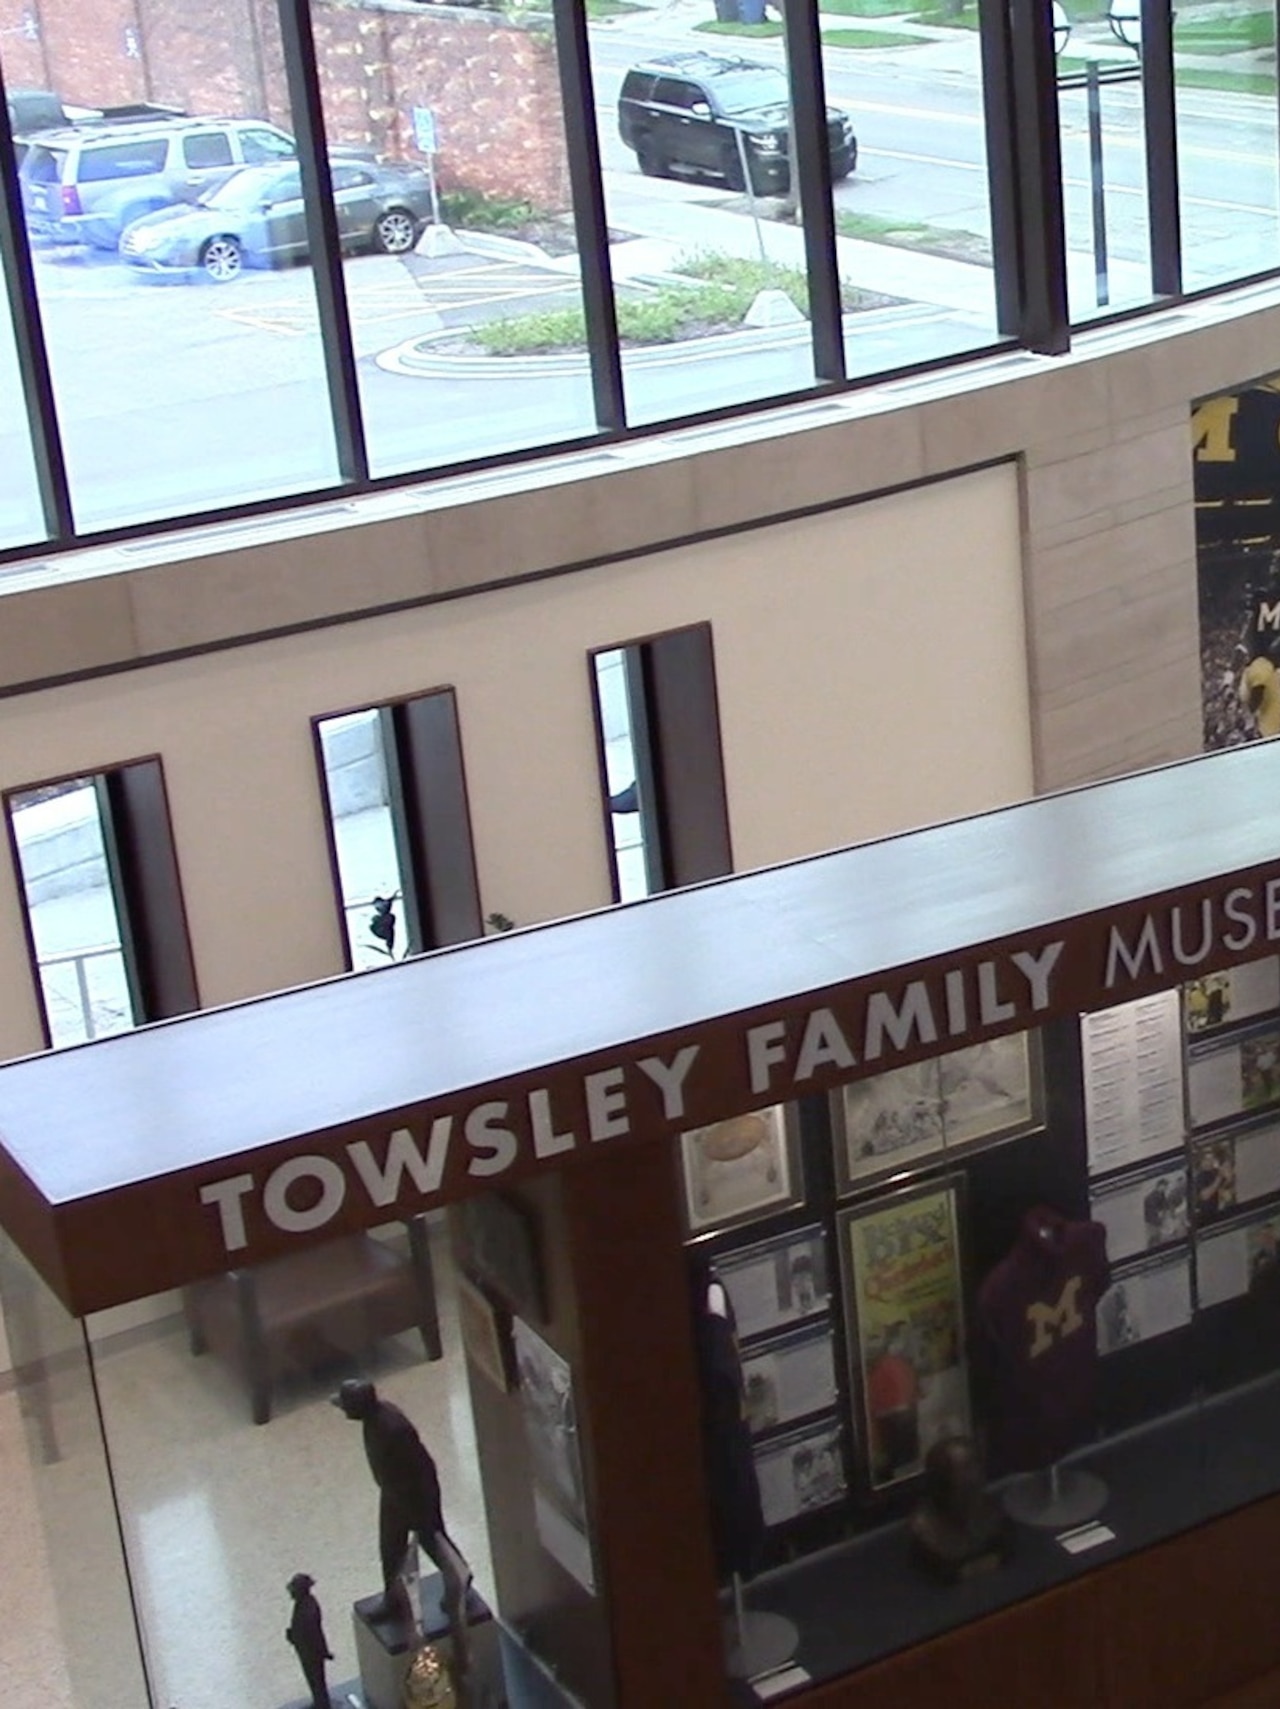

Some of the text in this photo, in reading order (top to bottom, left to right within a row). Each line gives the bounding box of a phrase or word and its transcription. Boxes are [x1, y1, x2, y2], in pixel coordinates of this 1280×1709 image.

[199, 1043, 700, 1252] TOWSLEY
[745, 940, 1066, 1095] FAMILY
[1025, 1275, 1085, 1359] M
